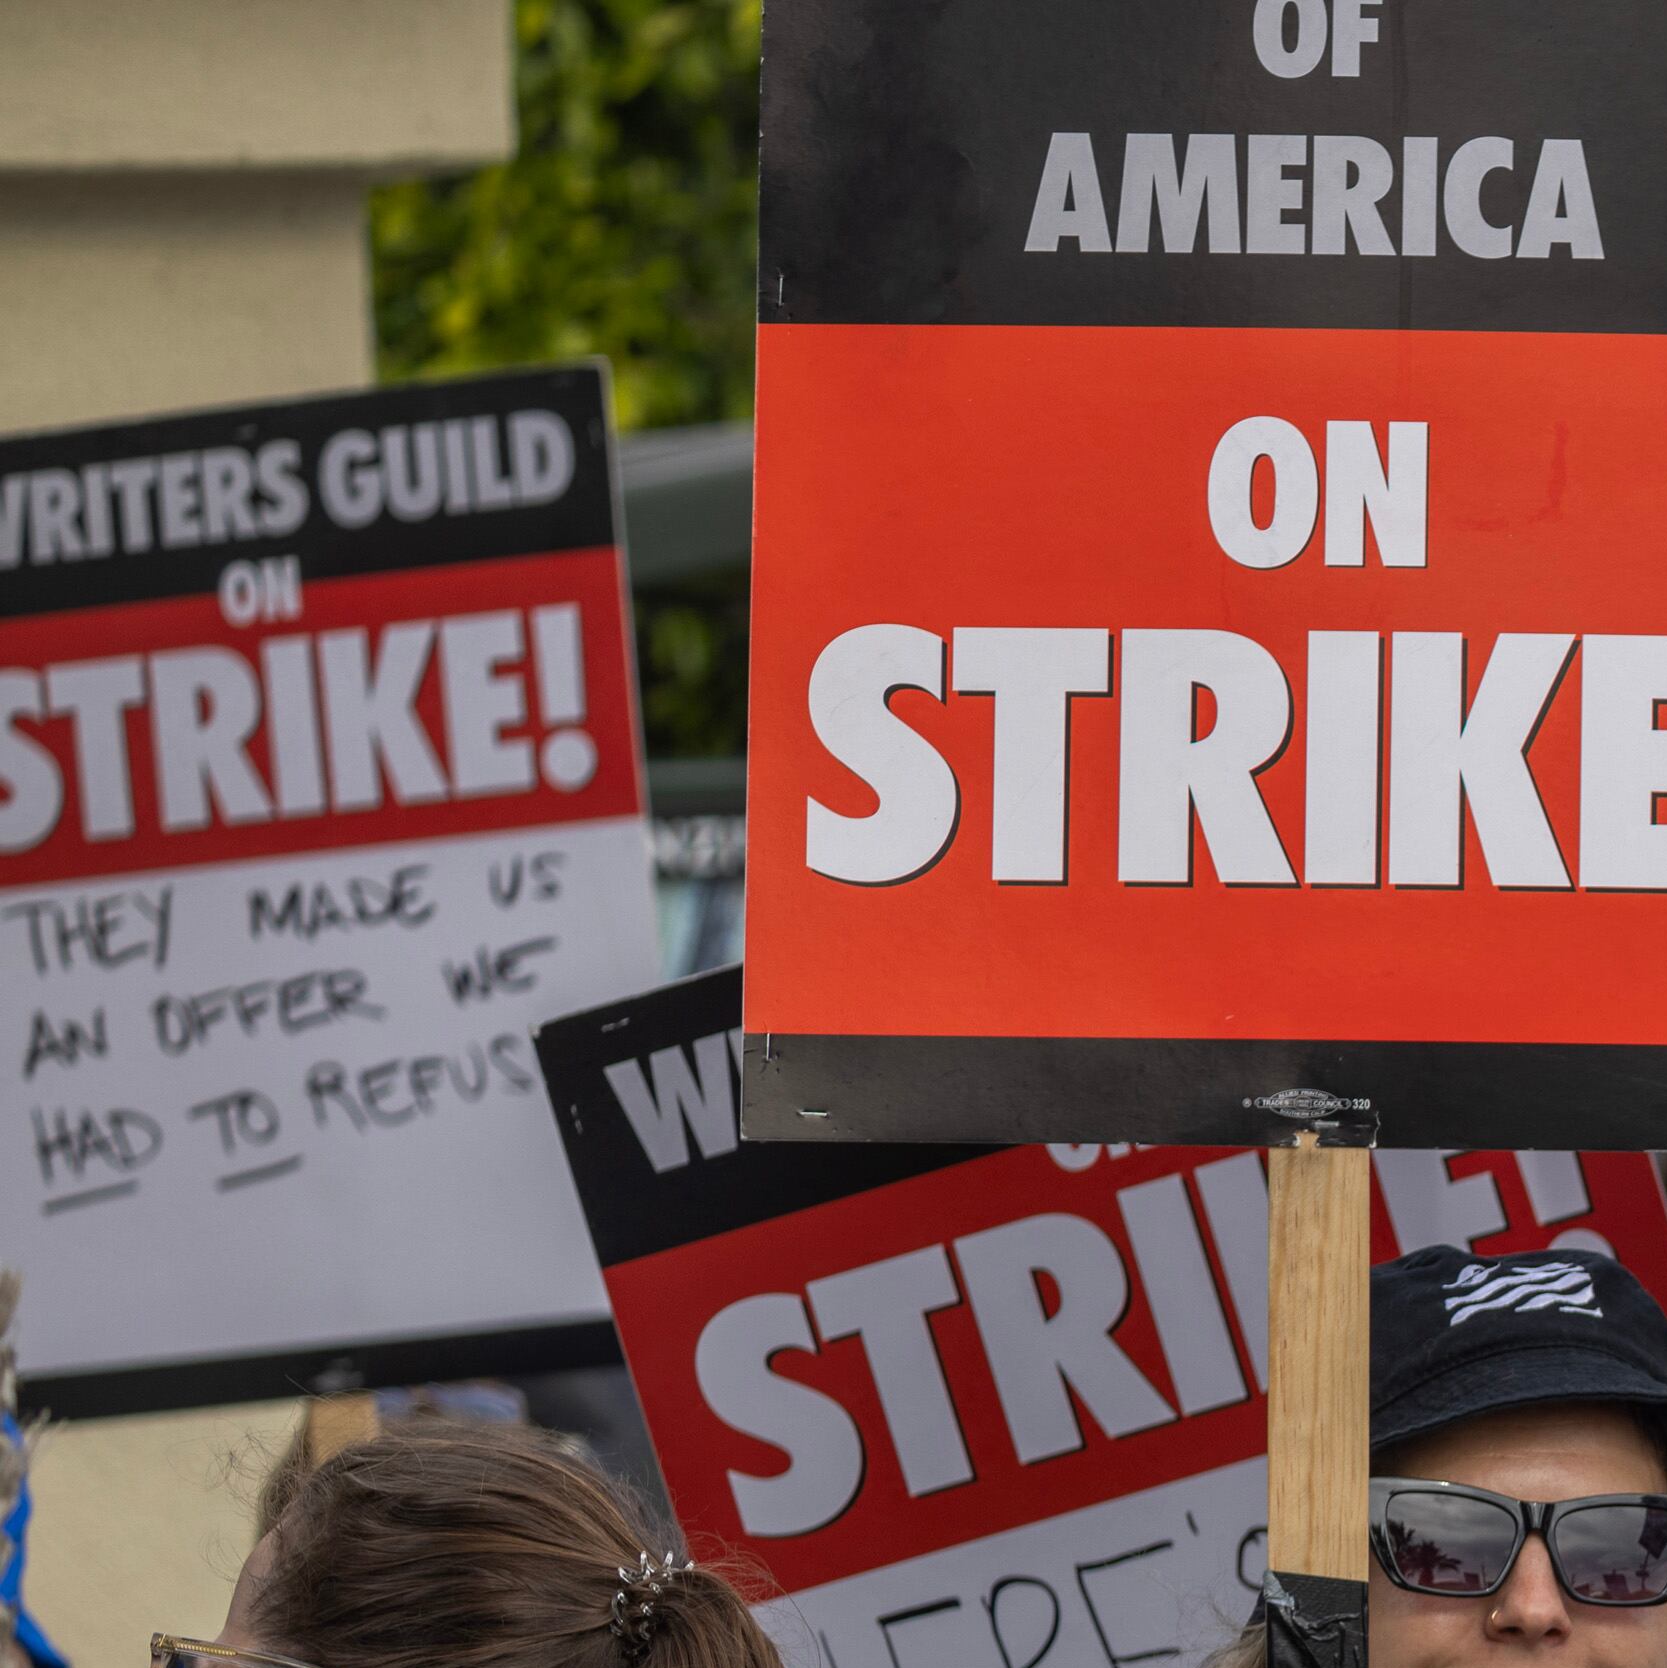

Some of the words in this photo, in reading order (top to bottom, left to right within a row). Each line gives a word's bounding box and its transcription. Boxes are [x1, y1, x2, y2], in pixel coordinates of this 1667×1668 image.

[1253, 0, 1380, 78] OF
[1024, 133, 1605, 260] AMERICA
[0, 438, 311, 571] RITERS
[322, 411, 576, 529] GUILD
[1207, 415, 1430, 569] ON
[218, 553, 303, 629] ON
[0, 601, 598, 853] STRIKE!
[5, 883, 173, 975] THEY
[246, 864, 436, 942] MADE
[490, 853, 567, 906] US
[21, 1007, 108, 1082] AN
[152, 968, 388, 1056] OFFER
[443, 934, 558, 1006] WE
[30, 1105, 163, 1185] HAD
[187, 1089, 281, 1156] TO
[305, 1032, 535, 1136] REFUS
[1352, 1098, 1371, 1110] 320
